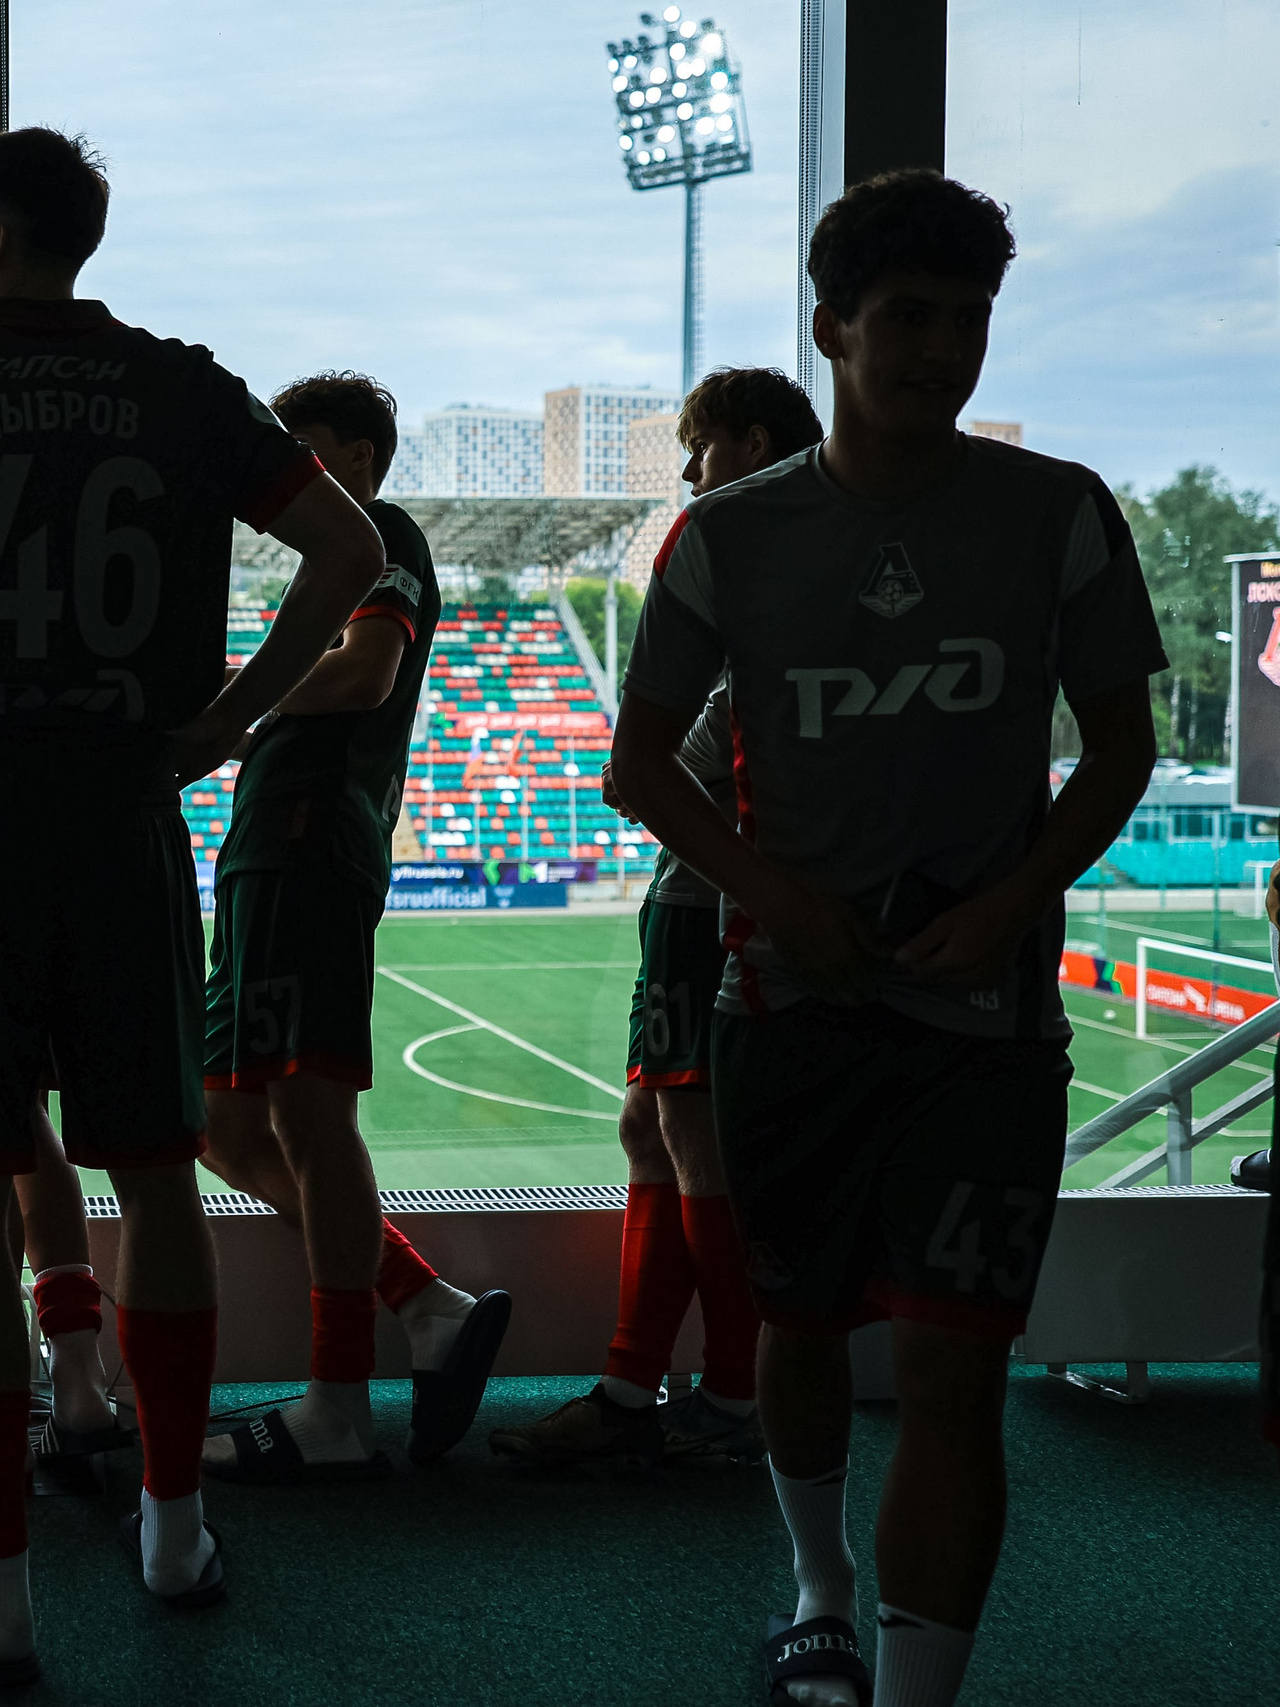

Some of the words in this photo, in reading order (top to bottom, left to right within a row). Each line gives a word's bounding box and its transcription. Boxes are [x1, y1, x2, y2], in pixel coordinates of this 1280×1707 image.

[245, 974, 301, 1054] 57
[644, 981, 691, 1057] 61
[925, 1180, 1046, 1300] 43
